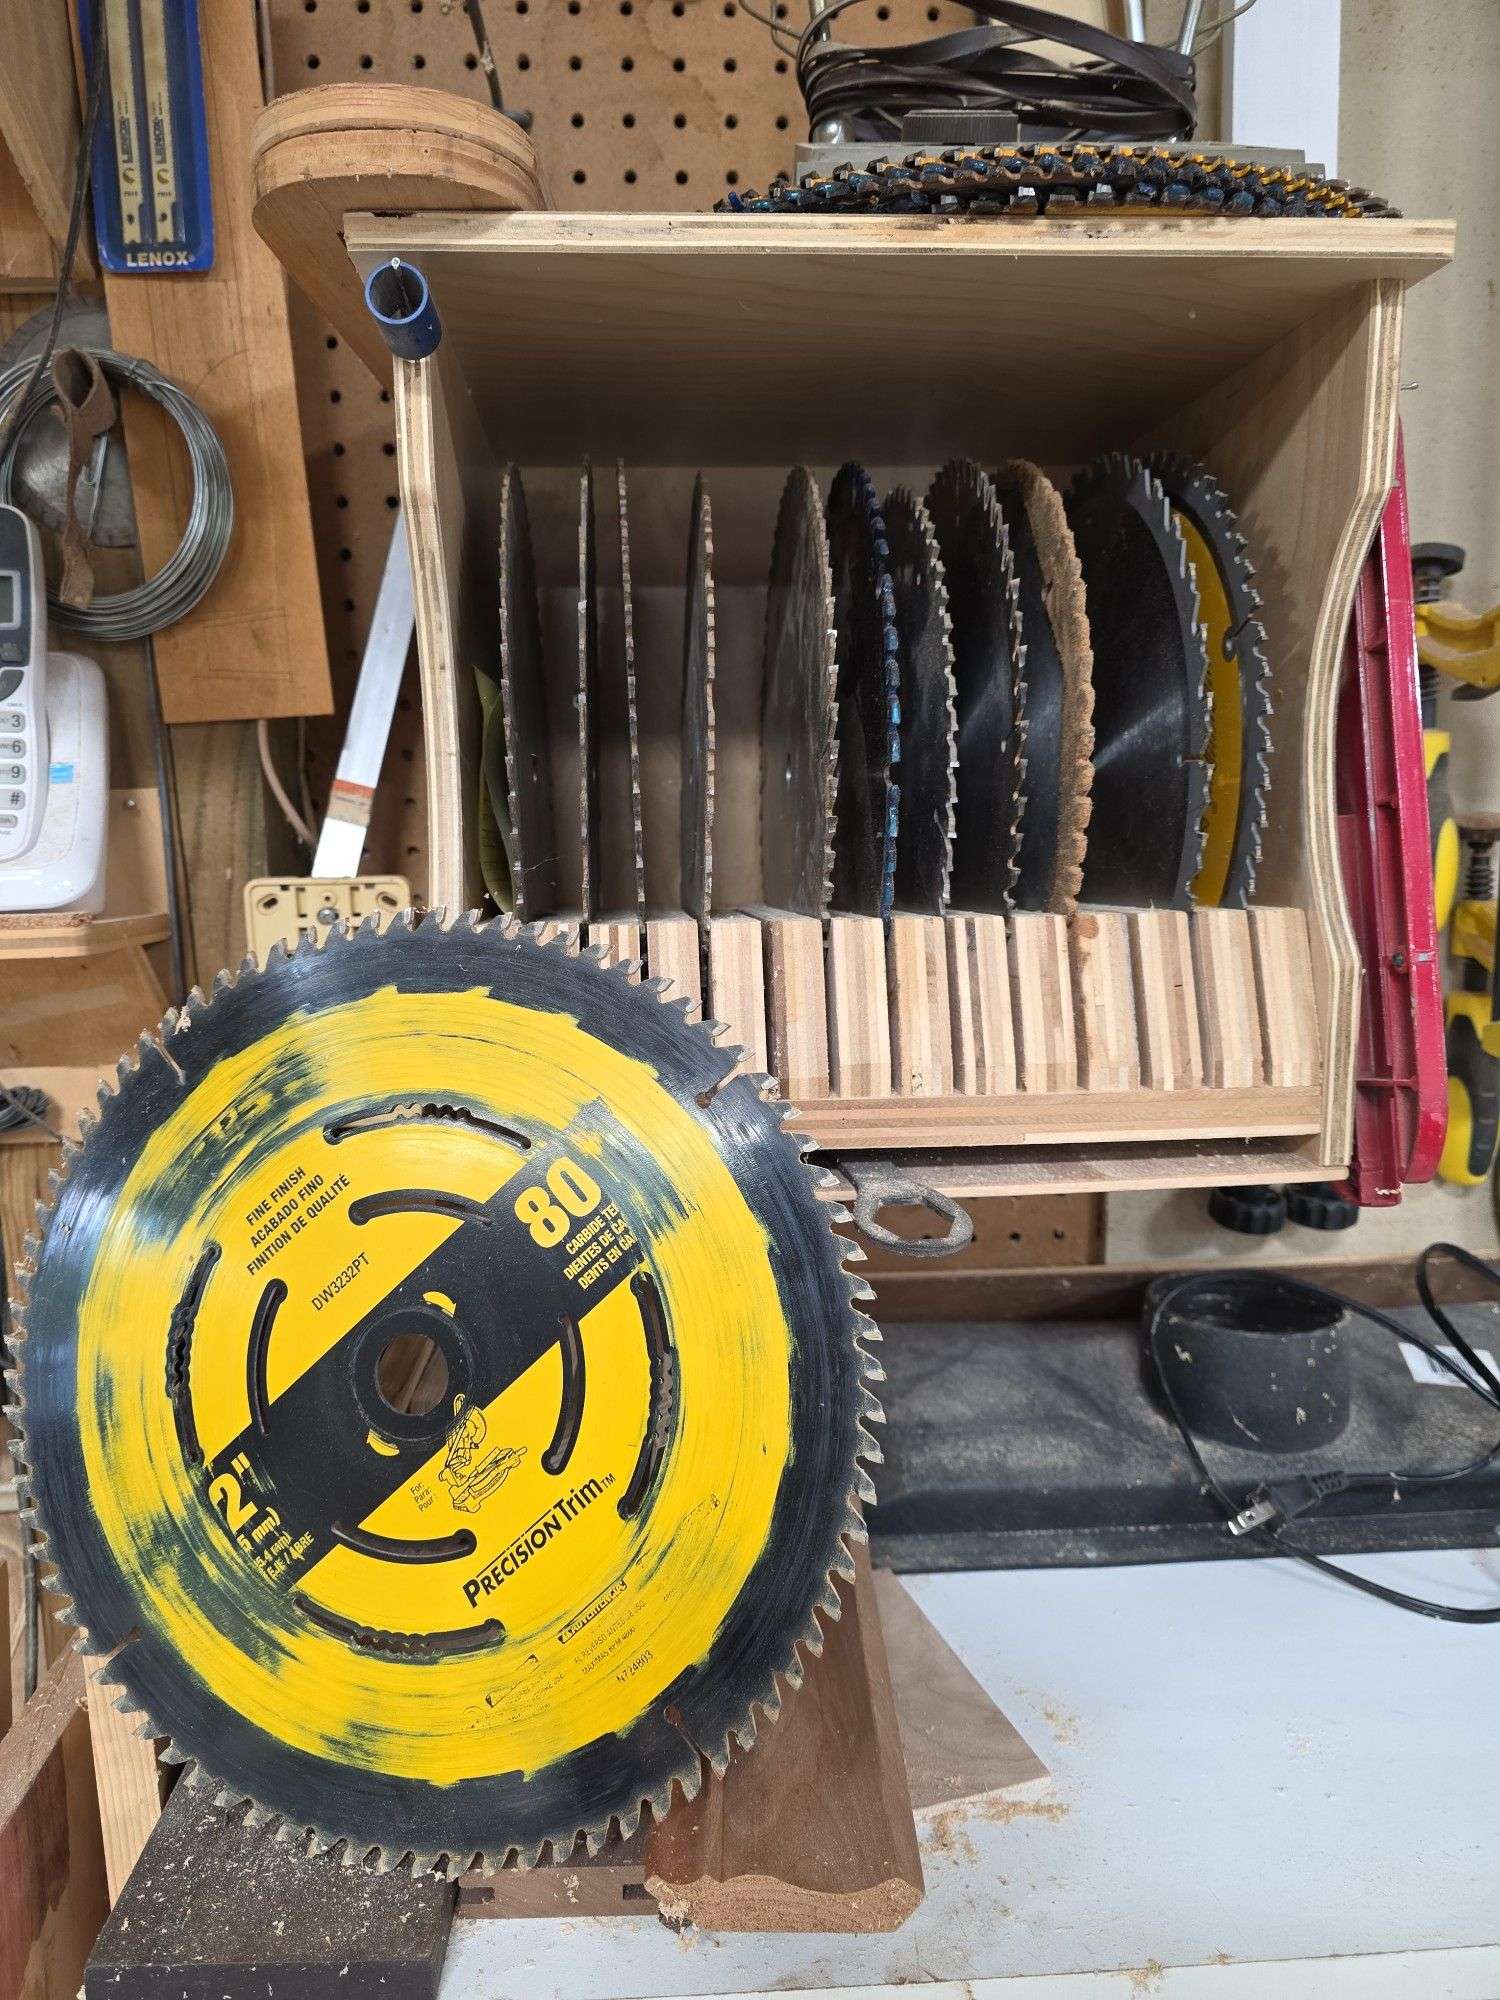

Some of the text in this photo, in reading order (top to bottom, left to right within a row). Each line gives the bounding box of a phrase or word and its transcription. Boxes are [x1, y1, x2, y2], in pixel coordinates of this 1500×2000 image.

[127, 251, 189, 267] LENOX
[11, 714, 21, 728] 3
[12, 740, 21, 754] 6
[11, 765, 20, 779] 9
[246, 1166, 306, 1226] FINE FINISH
[250, 1174, 324, 1248] ACABADO FINO
[514, 1156, 602, 1249] 80
[246, 1230, 292, 1275] FINITION
[290, 1215, 308, 1234] DE
[563, 1241, 602, 1280] DIENTES
[598, 1229, 615, 1247] DE
[566, 1215, 606, 1254] CARBIDE
[311, 1252, 370, 1312] DW3232PT
[578, 1257, 609, 1289] DENTS
[606, 1245, 622, 1263] EN
